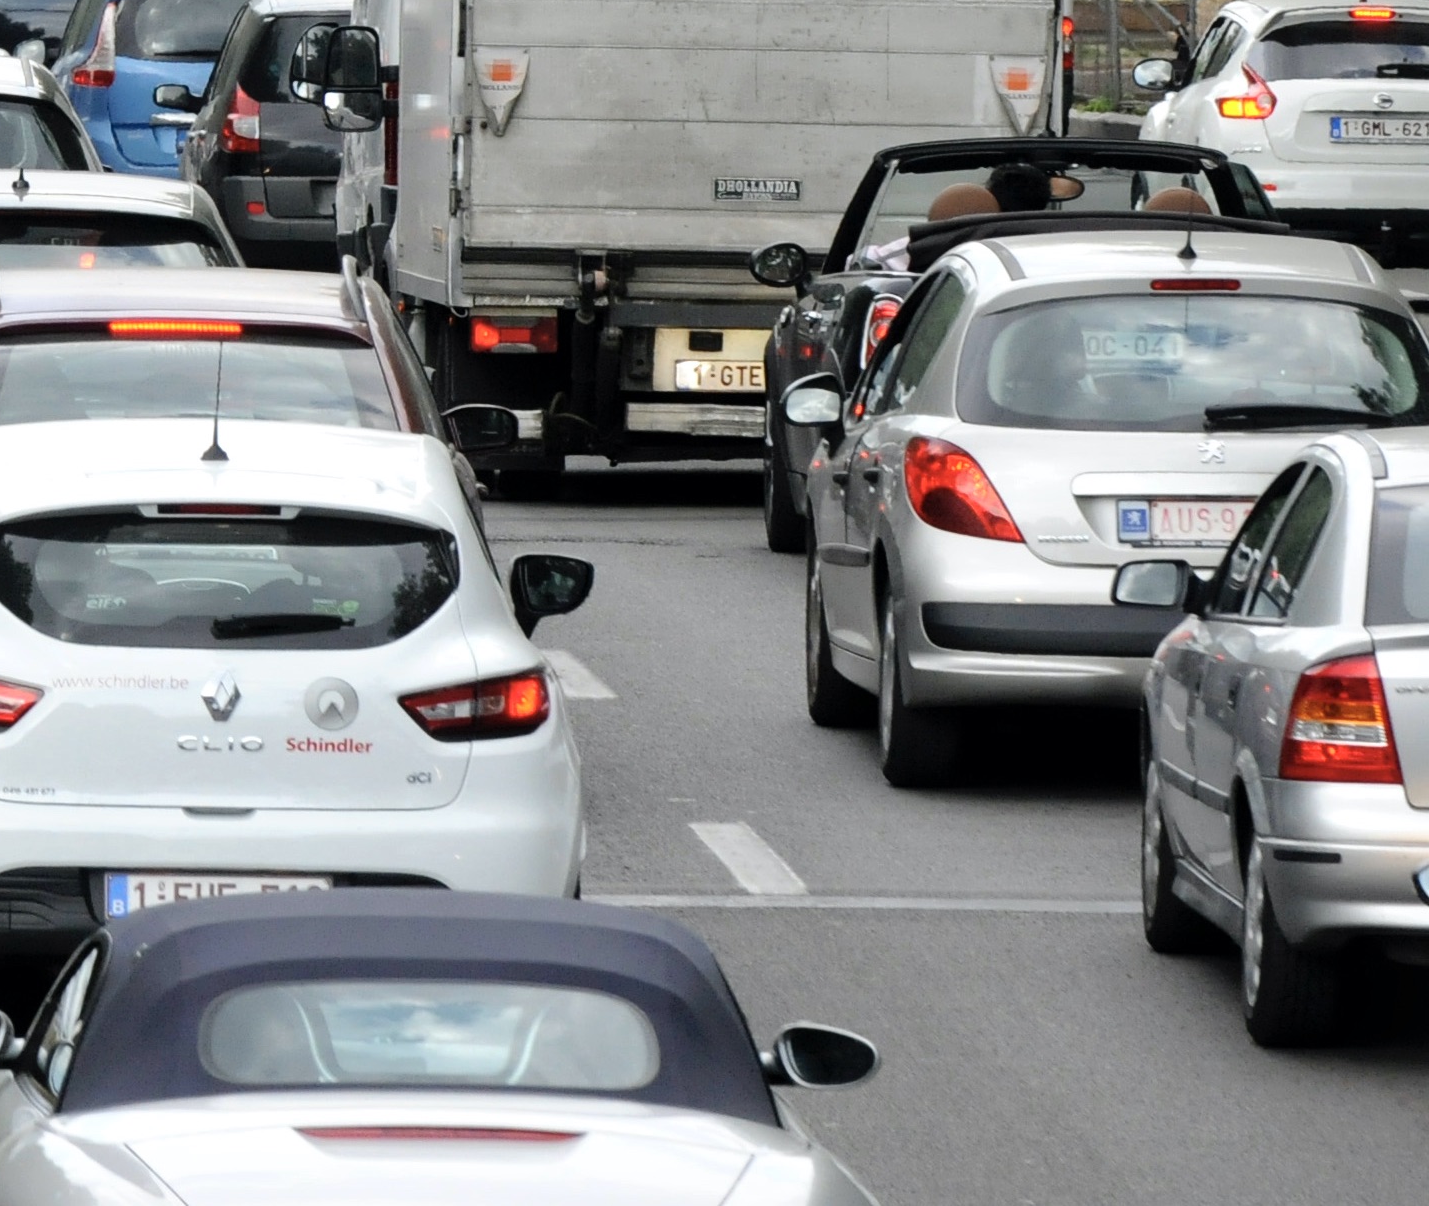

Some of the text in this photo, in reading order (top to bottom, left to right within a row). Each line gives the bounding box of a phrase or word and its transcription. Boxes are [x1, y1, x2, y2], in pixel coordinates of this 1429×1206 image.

[717, 180, 798, 193] DHOLLANDIA
[52, 675, 189, 690] www.schindler.be
[177, 735, 264, 752] CLIO
[286, 737, 373, 753] Schindler
